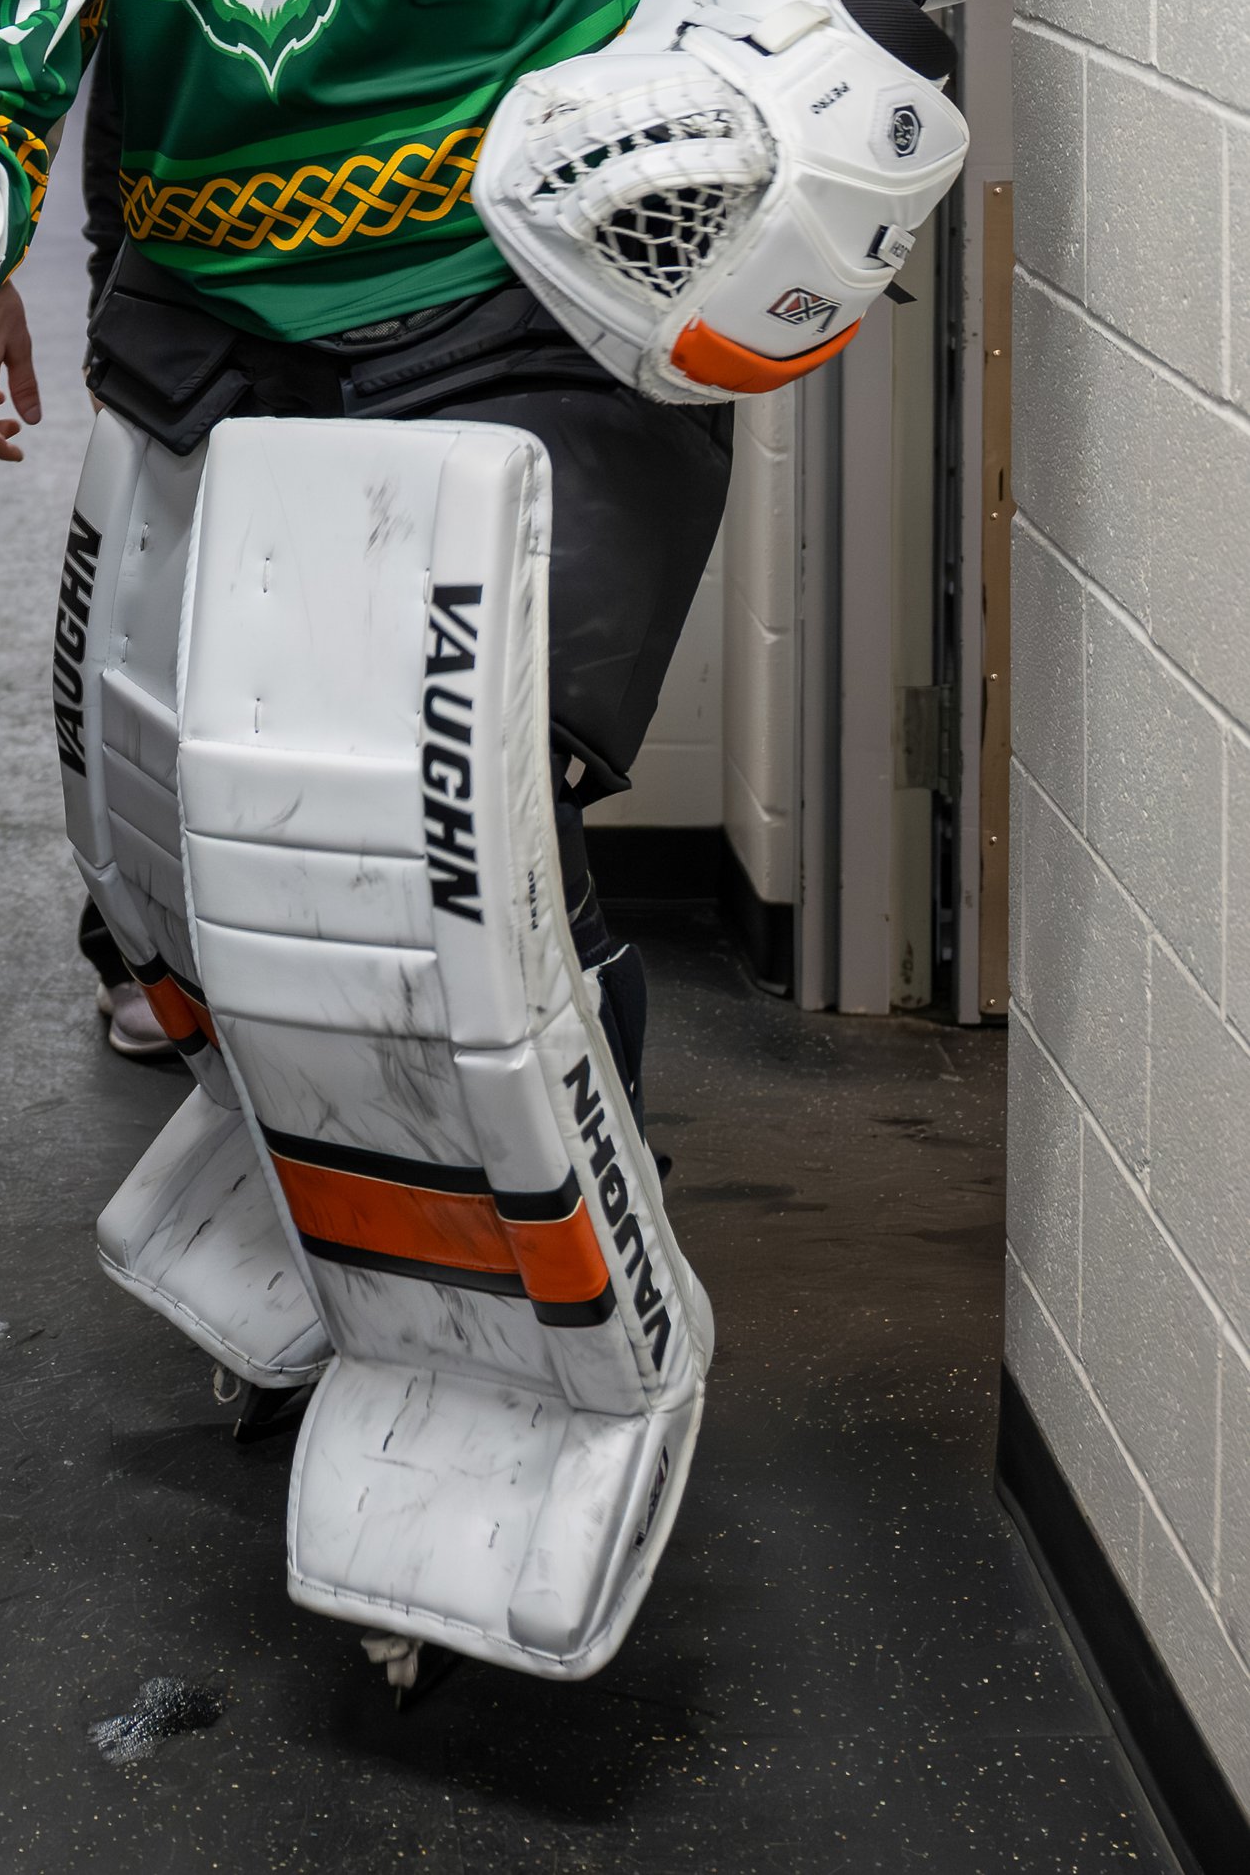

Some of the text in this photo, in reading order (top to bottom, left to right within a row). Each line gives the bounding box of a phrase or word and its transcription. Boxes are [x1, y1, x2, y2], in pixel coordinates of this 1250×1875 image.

[52, 505, 103, 779] VAUGHN
[422, 583, 485, 926] VAUGHN
[563, 1054, 672, 1372] VAUGHN
